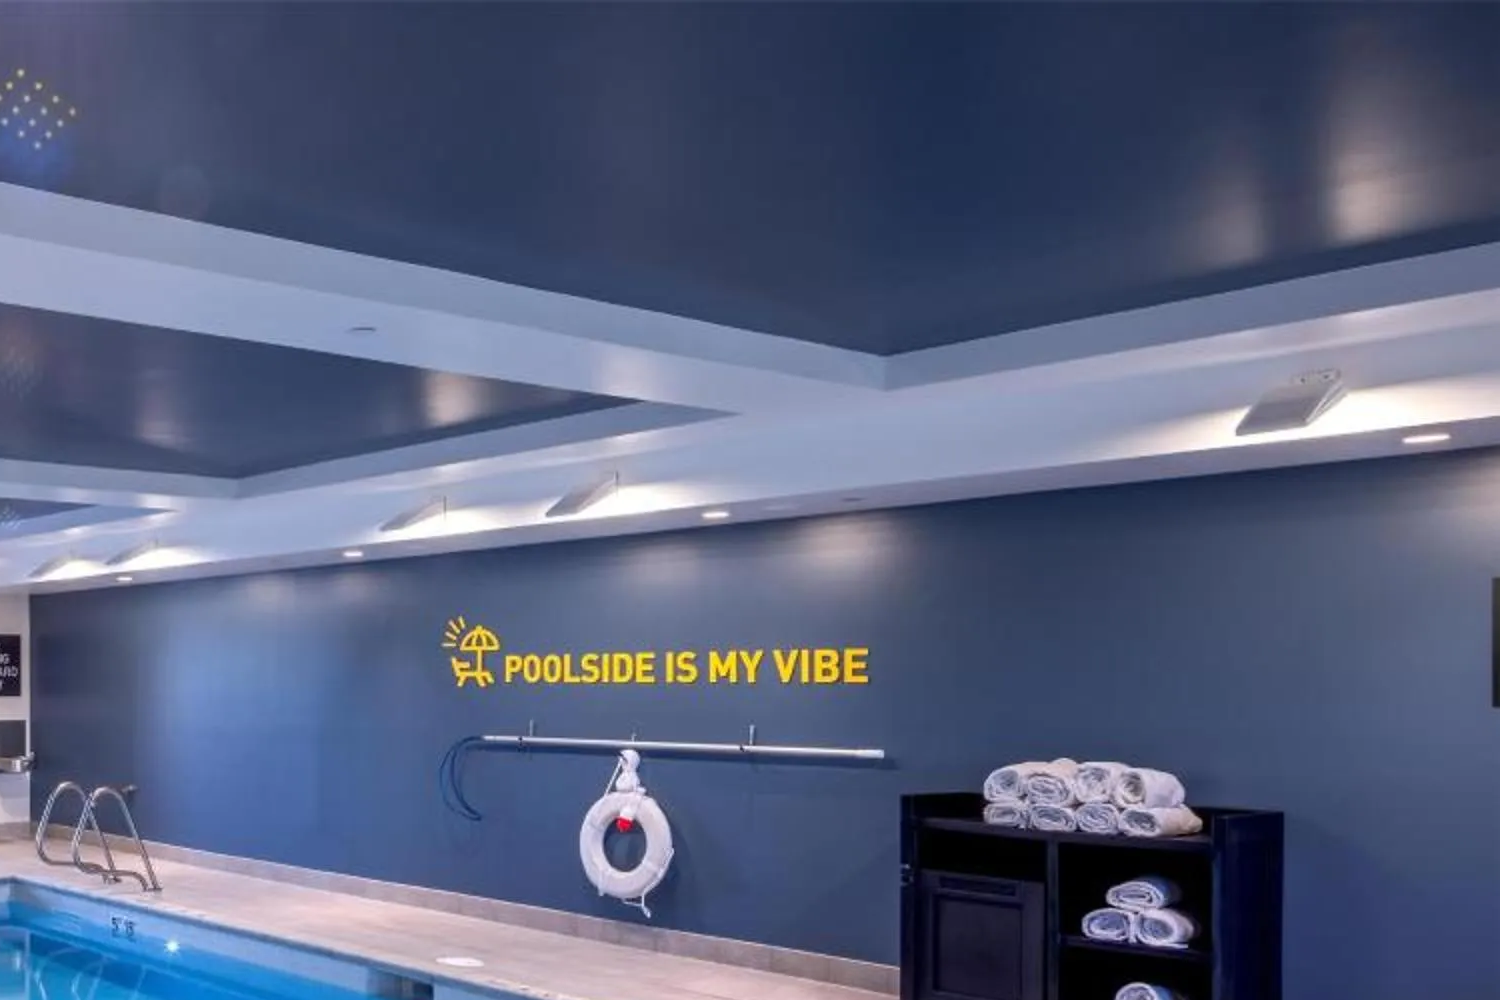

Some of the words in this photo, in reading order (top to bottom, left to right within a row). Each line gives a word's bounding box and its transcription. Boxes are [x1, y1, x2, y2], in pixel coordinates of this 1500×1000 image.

[505, 652, 655, 685] POOLSIDE
[665, 651, 698, 685] IS
[708, 650, 765, 685] MY
[772, 647, 869, 684] VIBE
